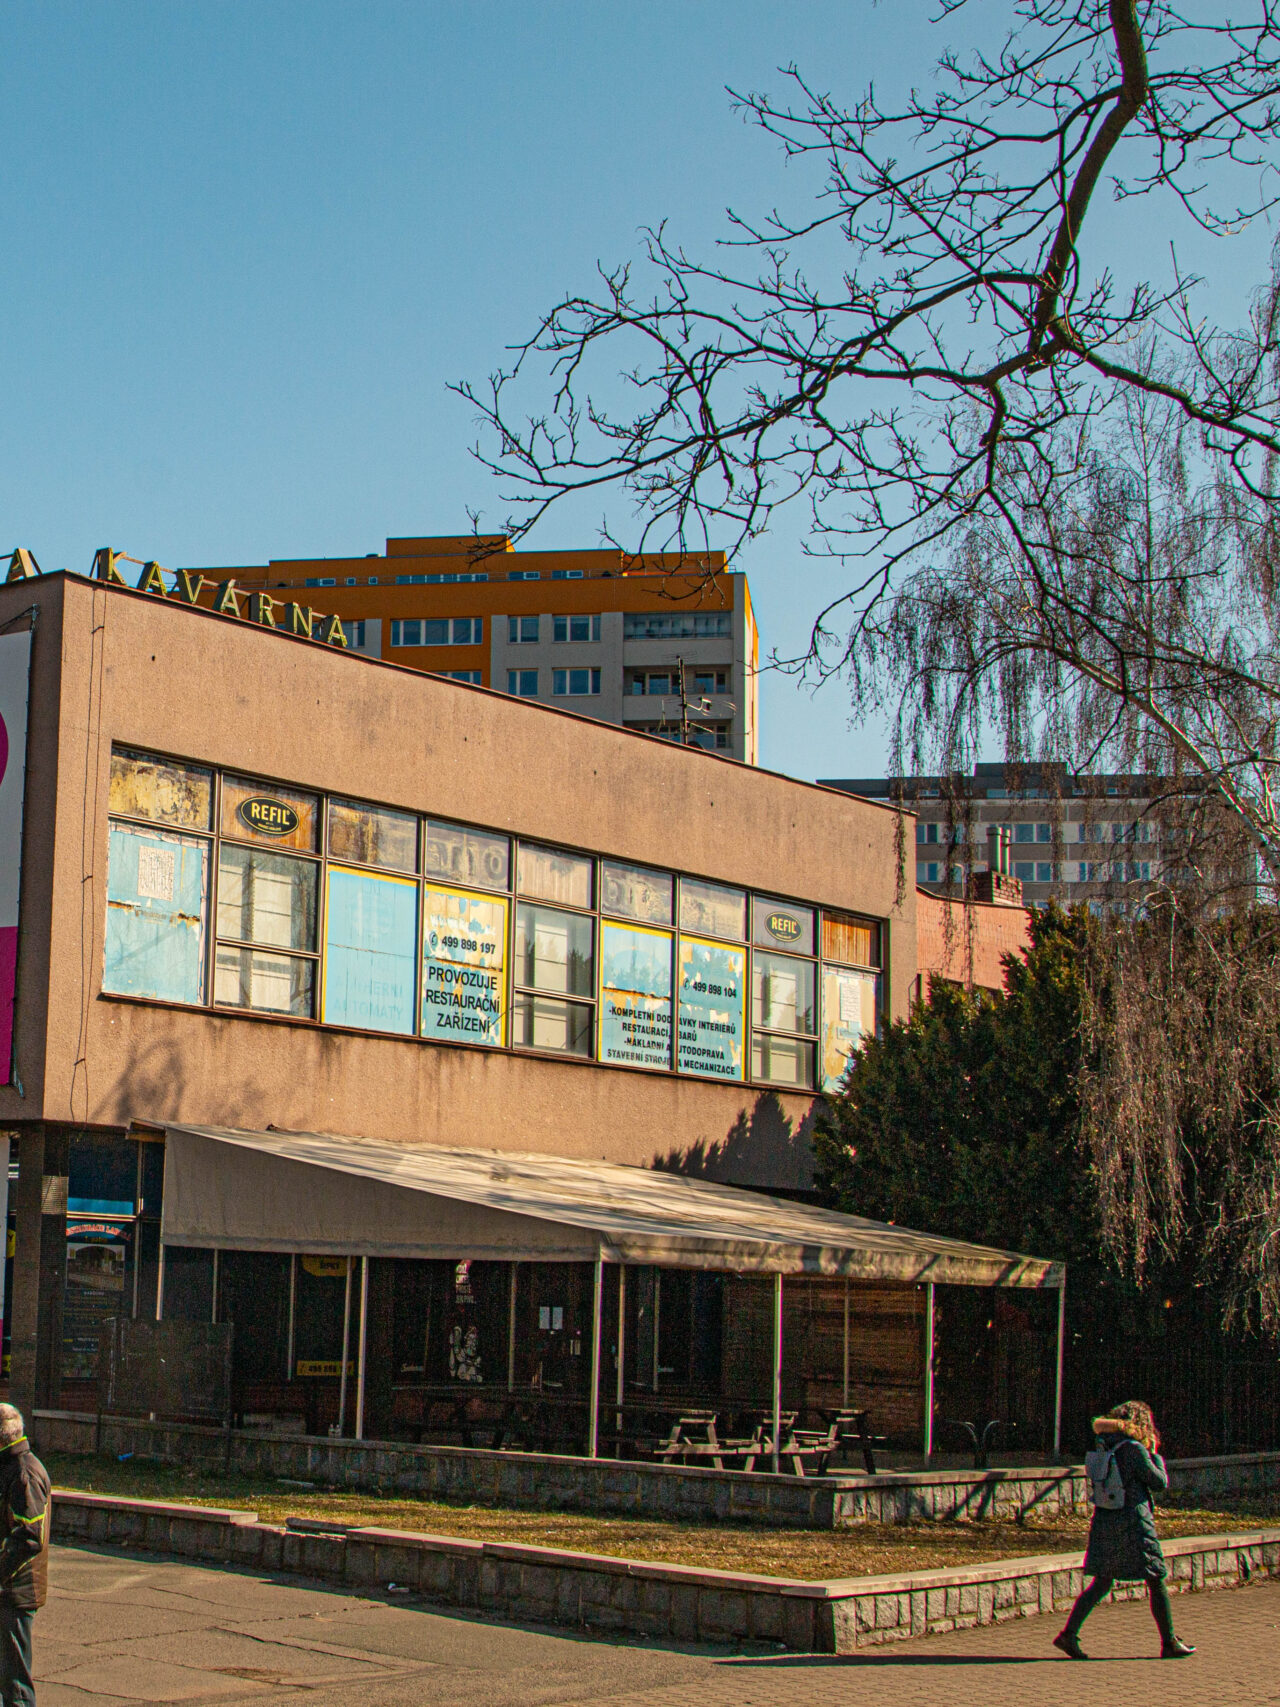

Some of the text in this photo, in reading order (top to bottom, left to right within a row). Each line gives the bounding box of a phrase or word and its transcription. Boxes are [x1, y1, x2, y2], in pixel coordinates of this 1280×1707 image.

[98, 547, 348, 648] KAVARNA
[251, 802, 290, 826] REFIL
[771, 916, 797, 934] REFIL
[441, 935, 496, 955] 499 898 197
[428, 966, 498, 991] PROVOZUJE
[693, 981, 737, 998] 499 898 104
[426, 988, 500, 1014] RESTAURAČNÍ
[436, 1012, 491, 1034] ZAŘÍZENÍ
[684, 1059, 736, 1076] MECHANIZACE
